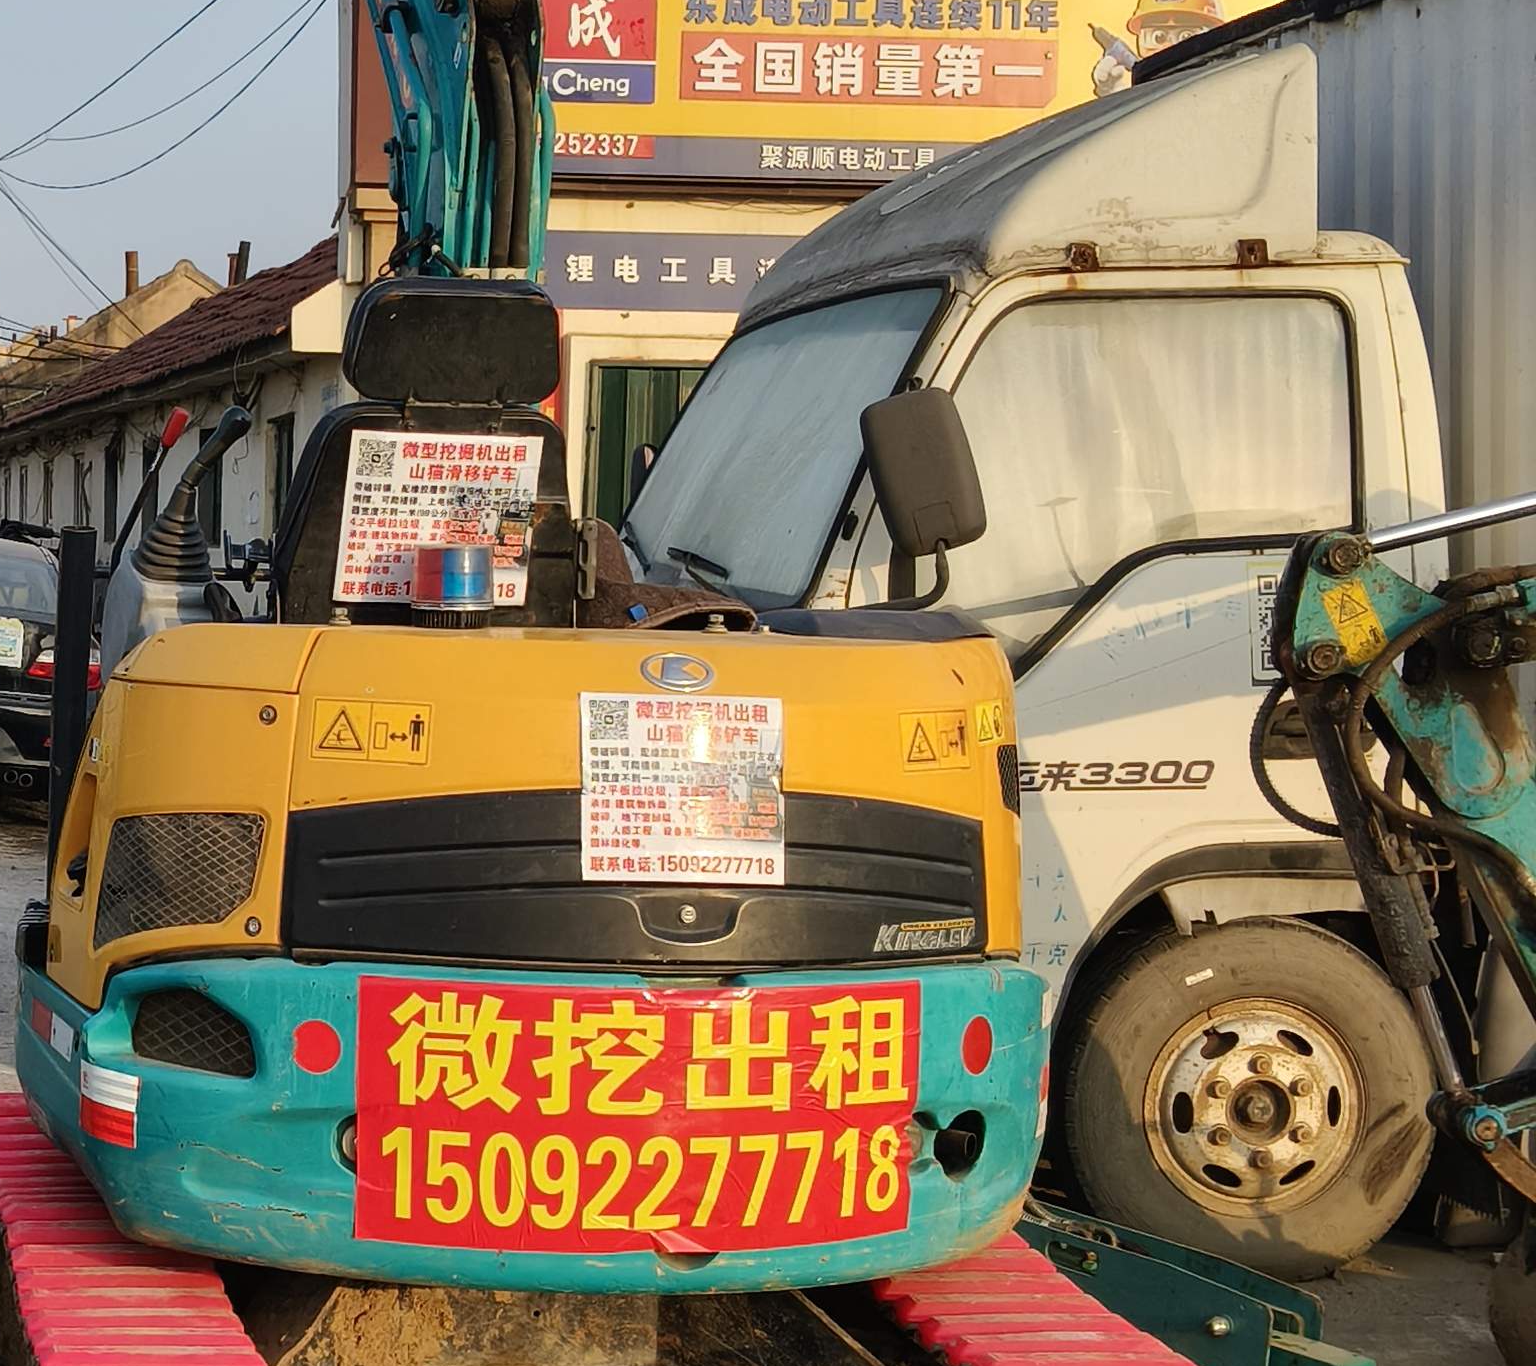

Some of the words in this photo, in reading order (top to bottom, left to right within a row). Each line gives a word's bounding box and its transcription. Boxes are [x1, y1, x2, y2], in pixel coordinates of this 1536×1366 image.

[692, 38, 1045, 97] 全国销量第一
[760, 145, 936, 171] 聚源顺电动工具
[402, 442, 527, 462] 微型挖掘机出租
[409, 464, 517, 483] 山猫滑移铲车
[388, 991, 909, 1115] 微挖出租
[381, 1124, 900, 1230] 15092277718
